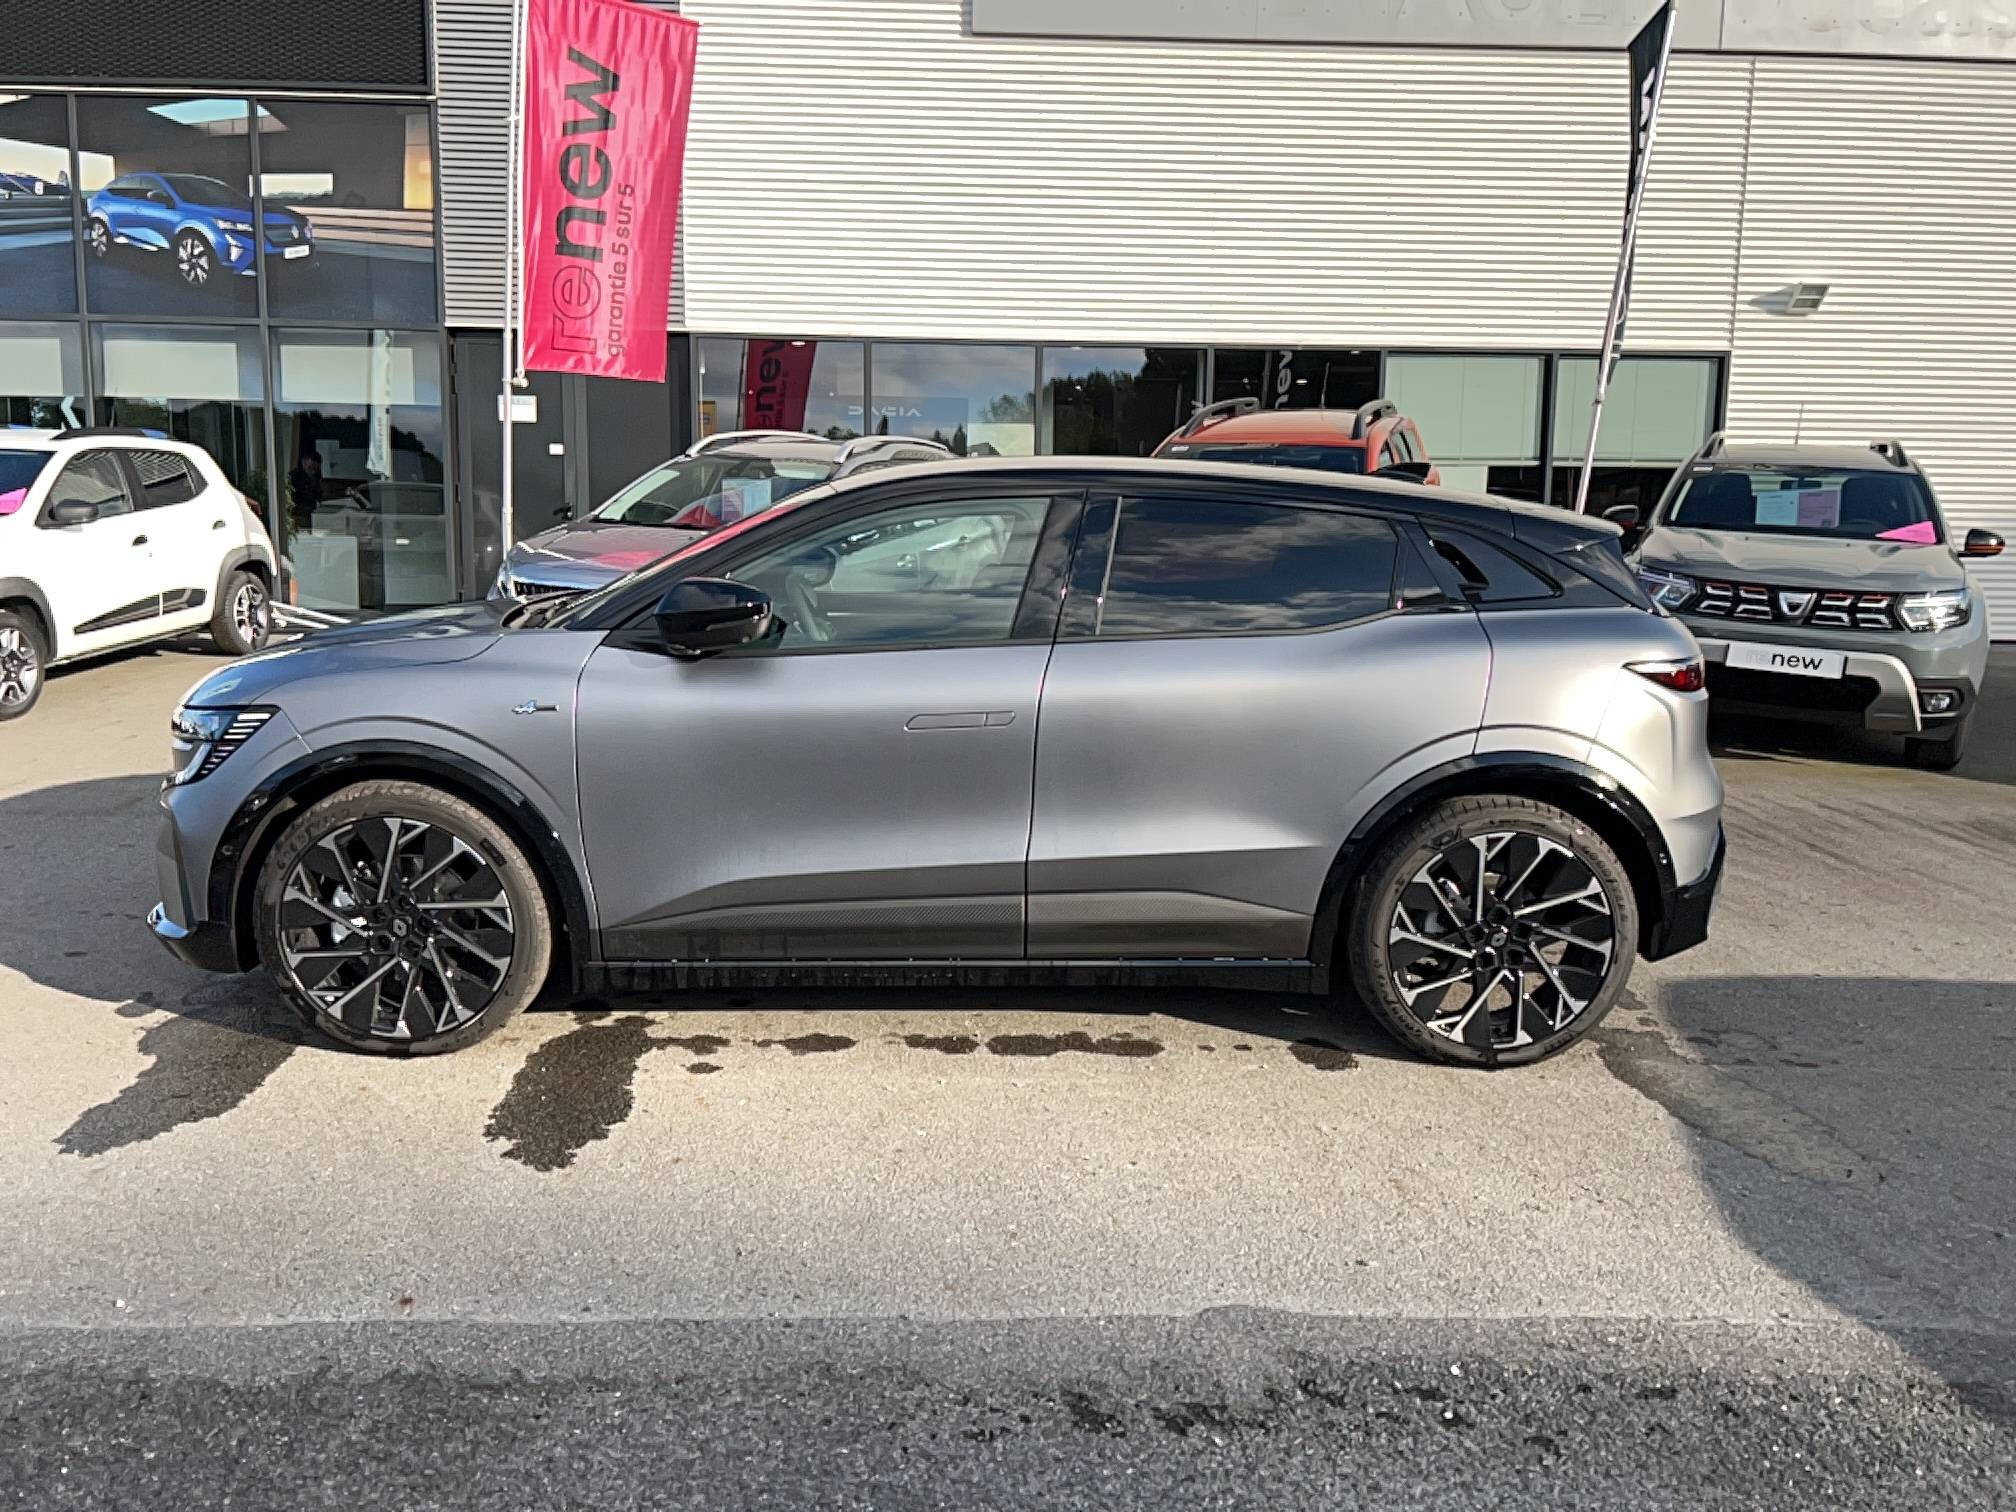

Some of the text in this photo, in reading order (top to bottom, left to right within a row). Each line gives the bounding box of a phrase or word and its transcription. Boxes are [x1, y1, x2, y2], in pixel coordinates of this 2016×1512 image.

[551, 45, 619, 355] renew
[608, 183, 635, 357] garantie 5 sur 5
